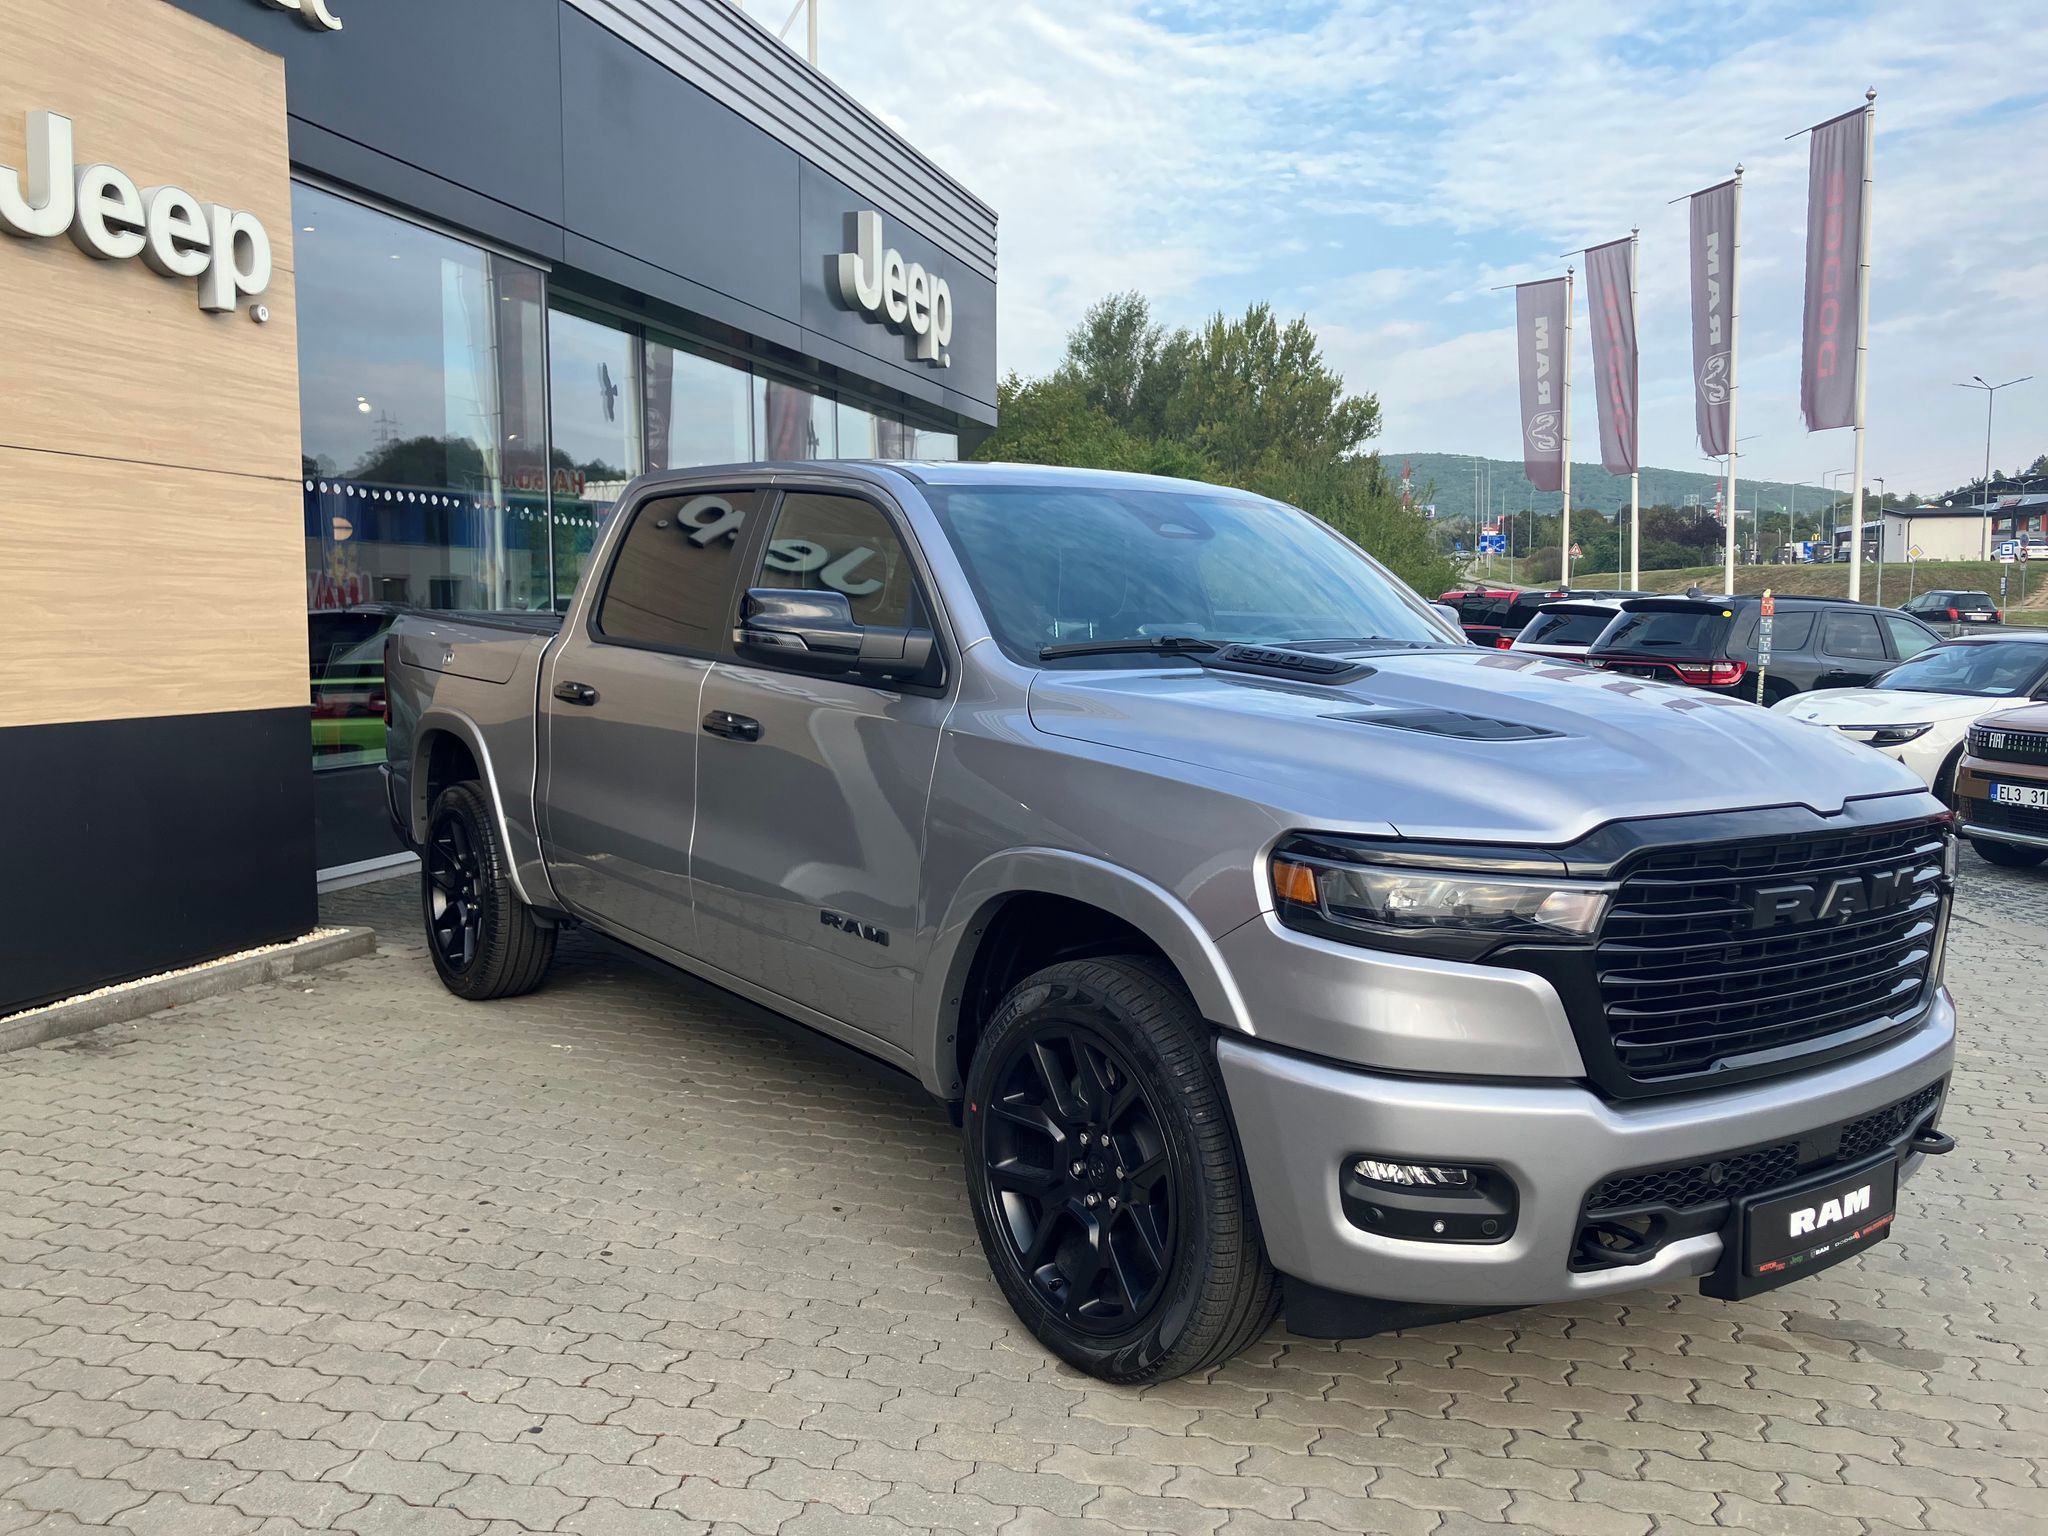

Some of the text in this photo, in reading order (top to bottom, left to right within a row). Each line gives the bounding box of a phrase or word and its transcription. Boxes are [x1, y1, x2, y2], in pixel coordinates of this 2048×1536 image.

[0, 111, 272, 313] Jeep
[842, 210, 953, 361] Jeep
[1989, 732, 2006, 749] FIAT
[2000, 786, 2048, 806] EL3 31
[1752, 866, 1914, 929] RAM
[820, 909, 889, 947] RAM
[1789, 1184, 1871, 1238] RAM
[1816, 1245, 1830, 1256] RAM
